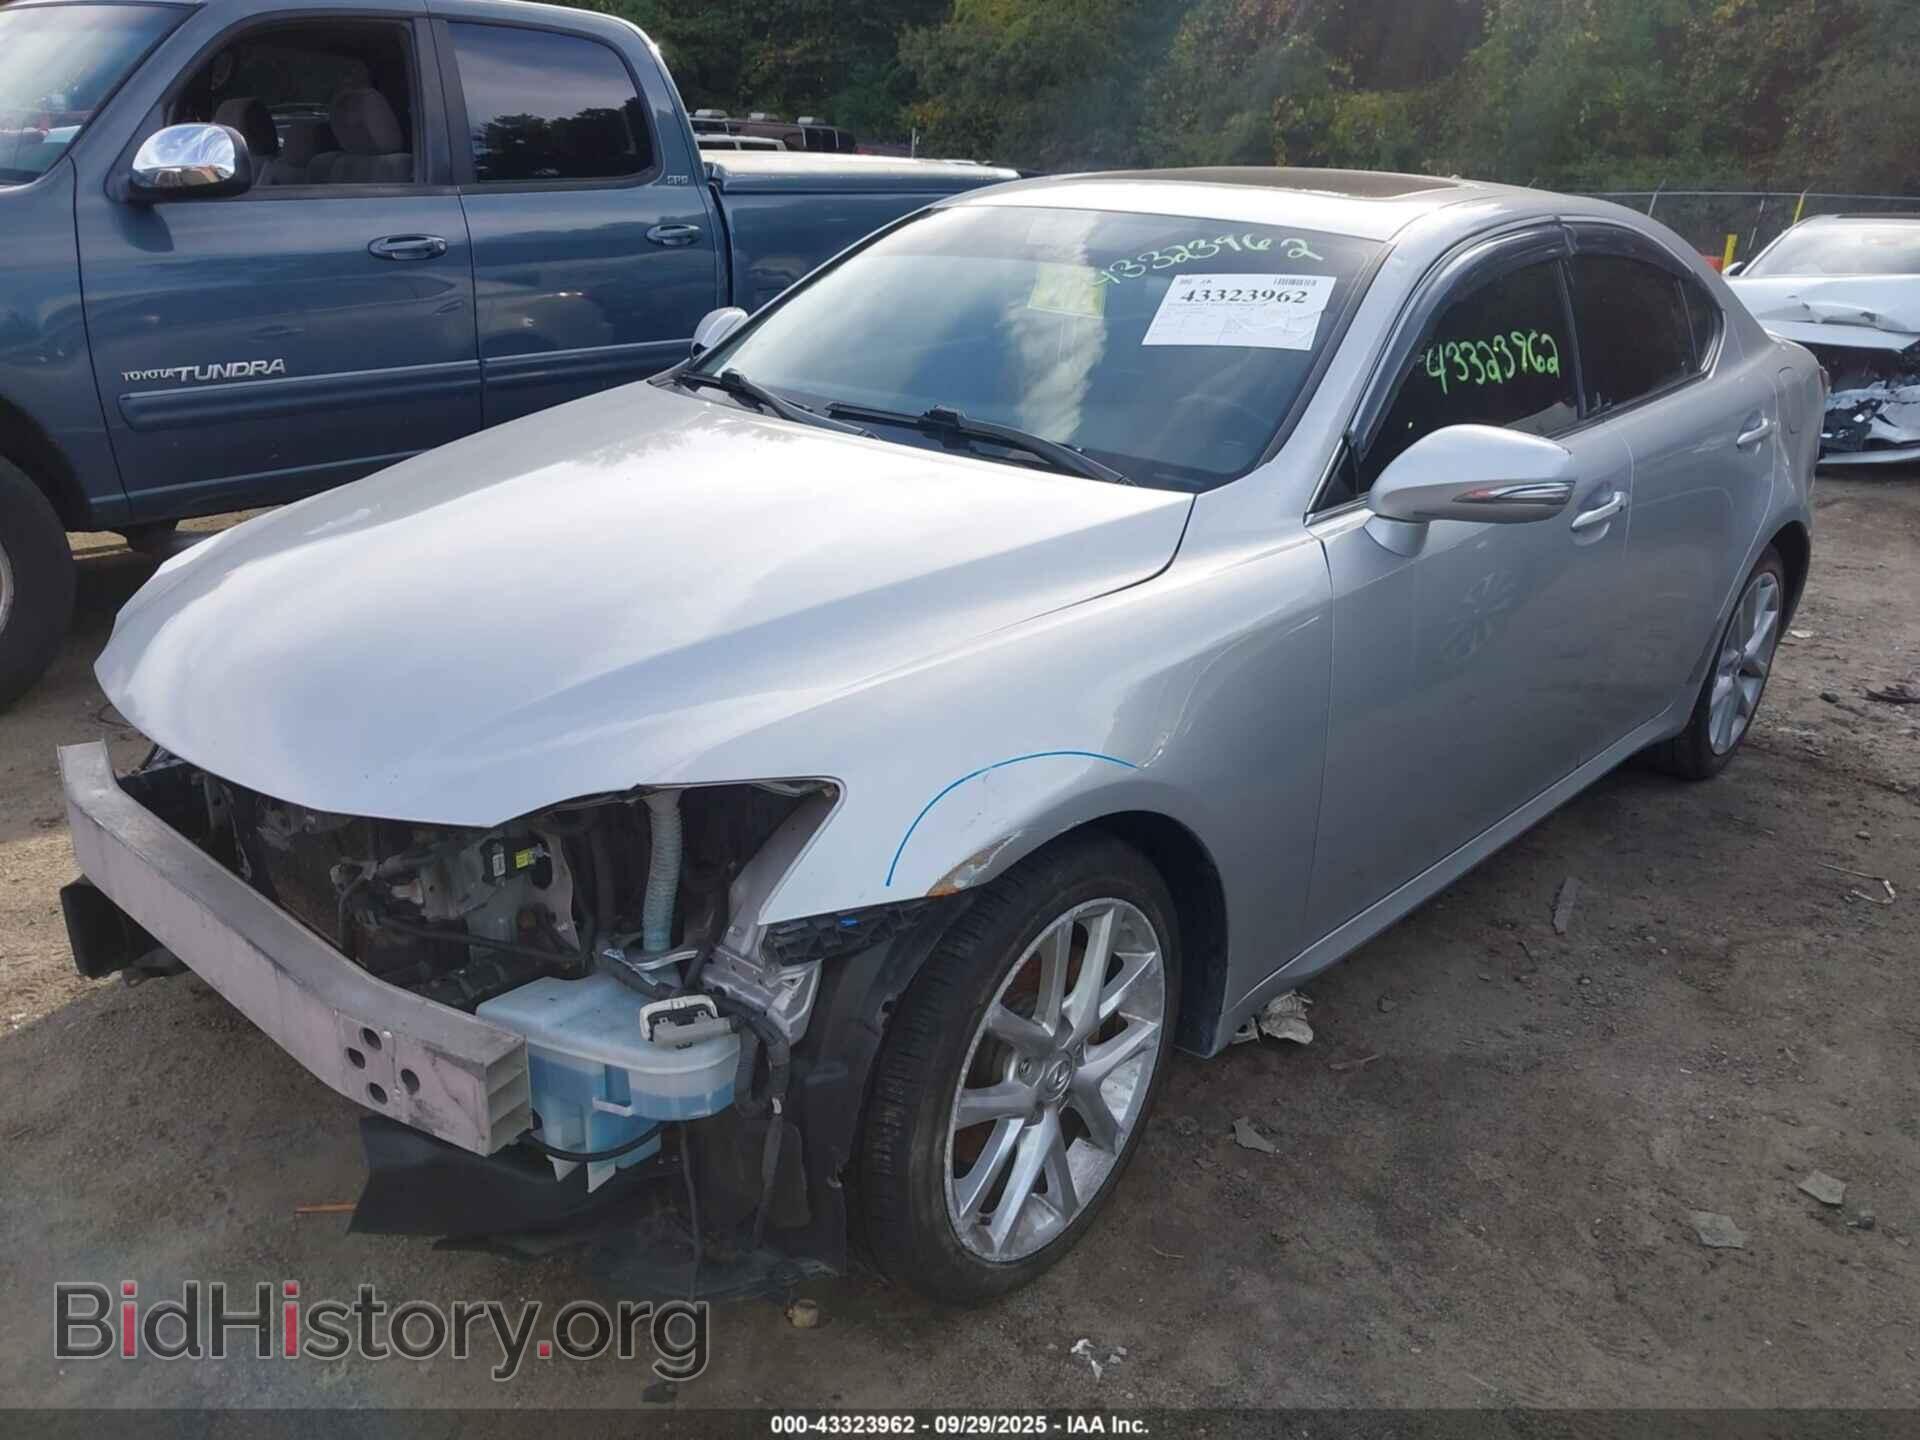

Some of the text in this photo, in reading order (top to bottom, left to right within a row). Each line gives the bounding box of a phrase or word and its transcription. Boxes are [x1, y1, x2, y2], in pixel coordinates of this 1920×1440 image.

[1091, 232, 1324, 287] 43323962
[1180, 288, 1309, 304] 43323962
[121, 358, 286, 382] TOYOTA TUNDRA
[1426, 329, 1560, 395] 43323962
